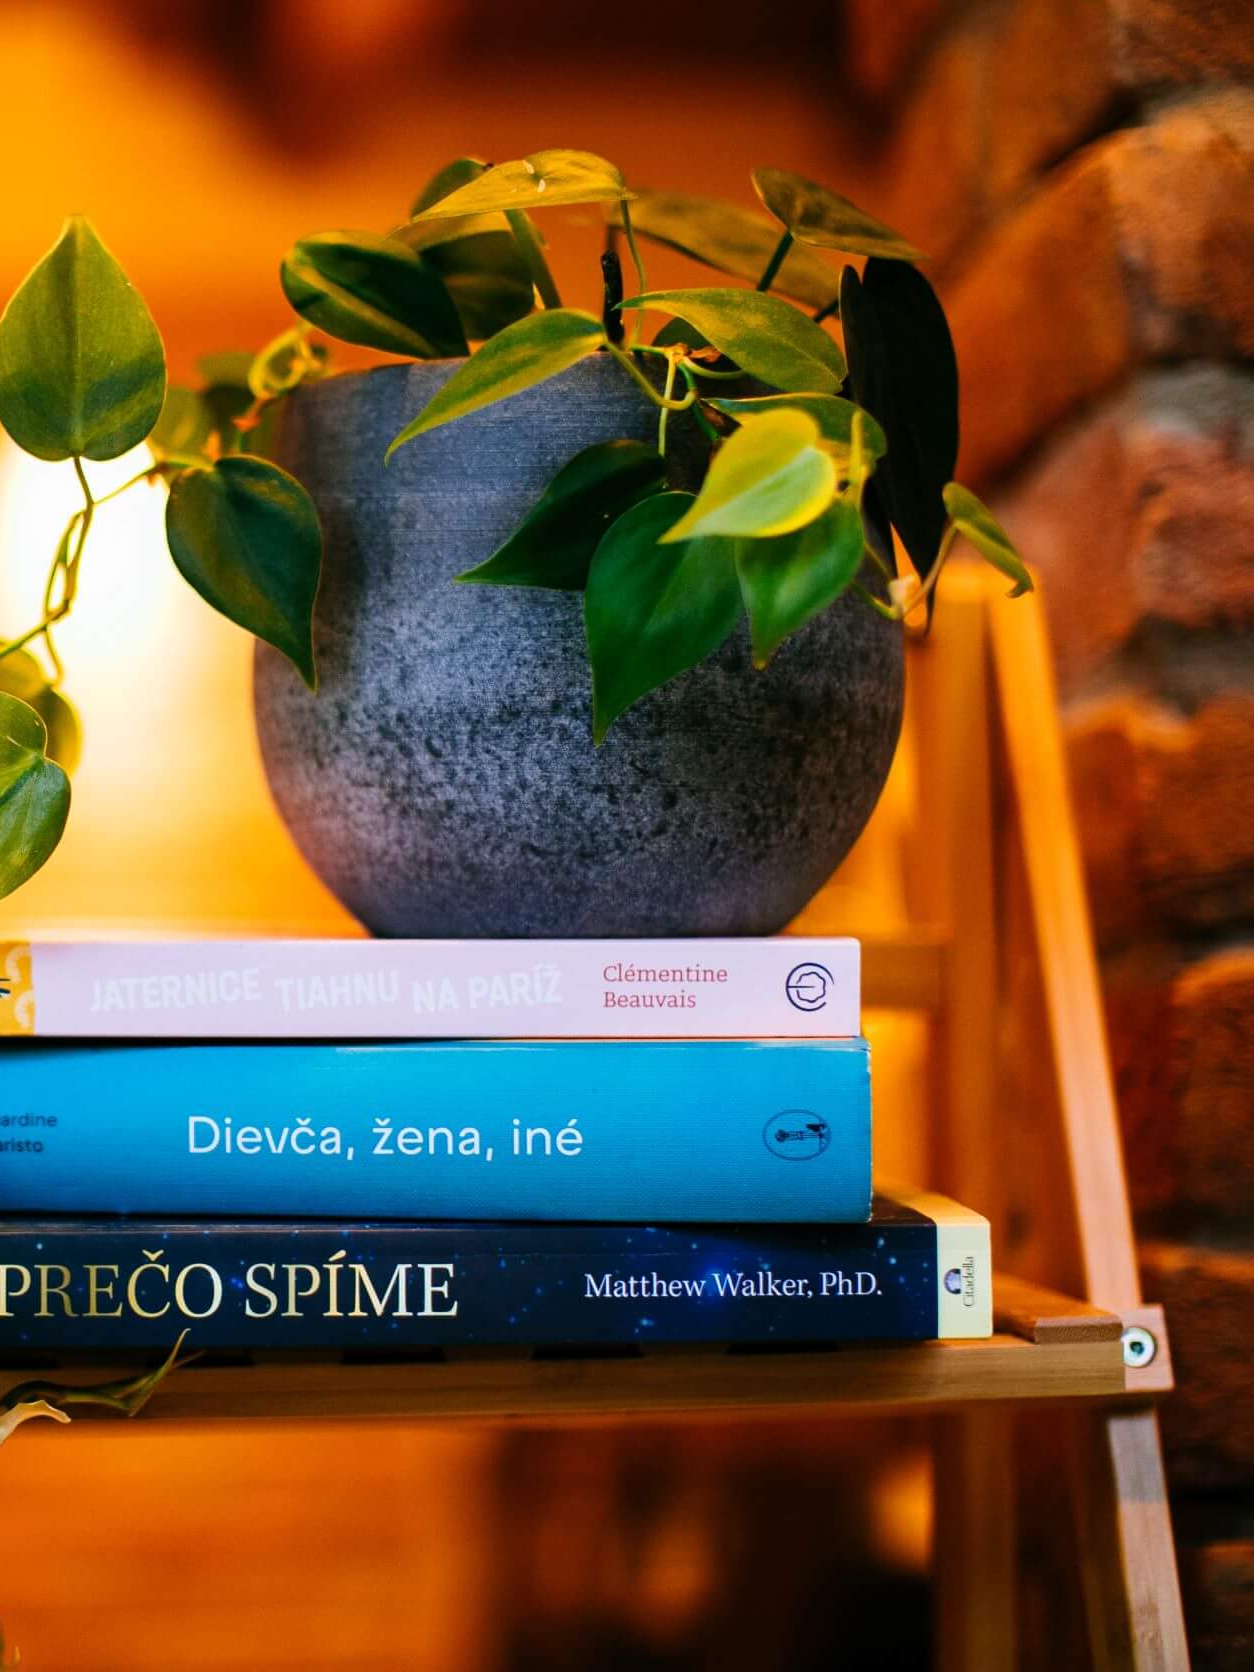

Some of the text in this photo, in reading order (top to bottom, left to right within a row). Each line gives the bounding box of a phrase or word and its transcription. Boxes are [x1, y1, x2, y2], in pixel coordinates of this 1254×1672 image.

[89, 963, 564, 1015] JATERNICE TIAHNU NA PARÍŽ
[602, 963, 728, 983] Clémentine
[602, 991, 697, 1009] Beauvais
[187, 1116, 584, 1162] Dievča, žena, iné
[245, 1249, 459, 1318] SPÍME
[584, 1271, 883, 1299] Matthew Walker, PhD.
